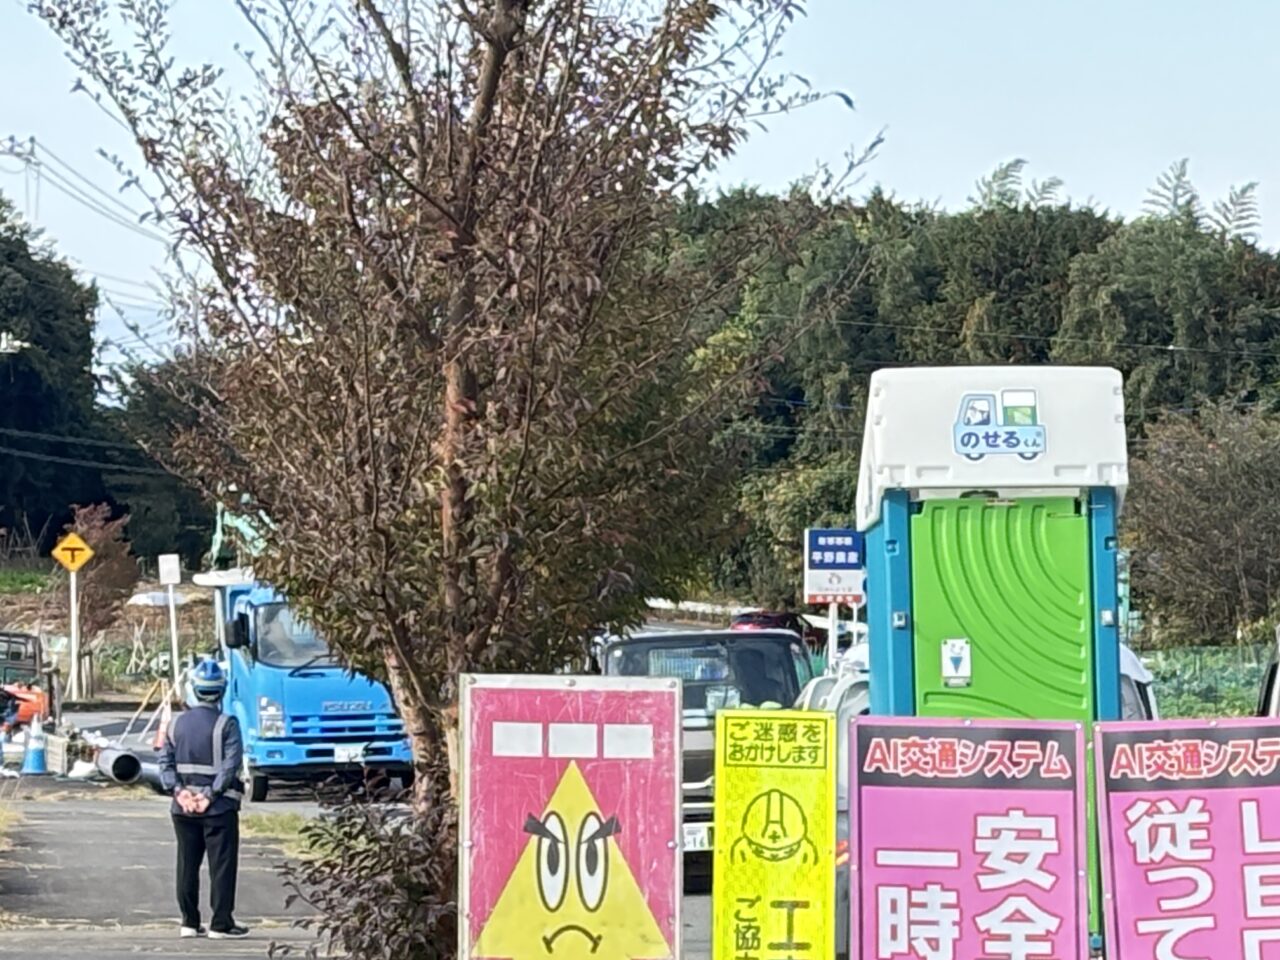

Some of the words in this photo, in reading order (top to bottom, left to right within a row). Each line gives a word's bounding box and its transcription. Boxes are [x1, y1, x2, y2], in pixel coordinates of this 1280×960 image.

[729, 721, 821, 743] ご迷惑を
[728, 743, 822, 764] おかけします
[863, 736, 1073, 780] AI交通システム
